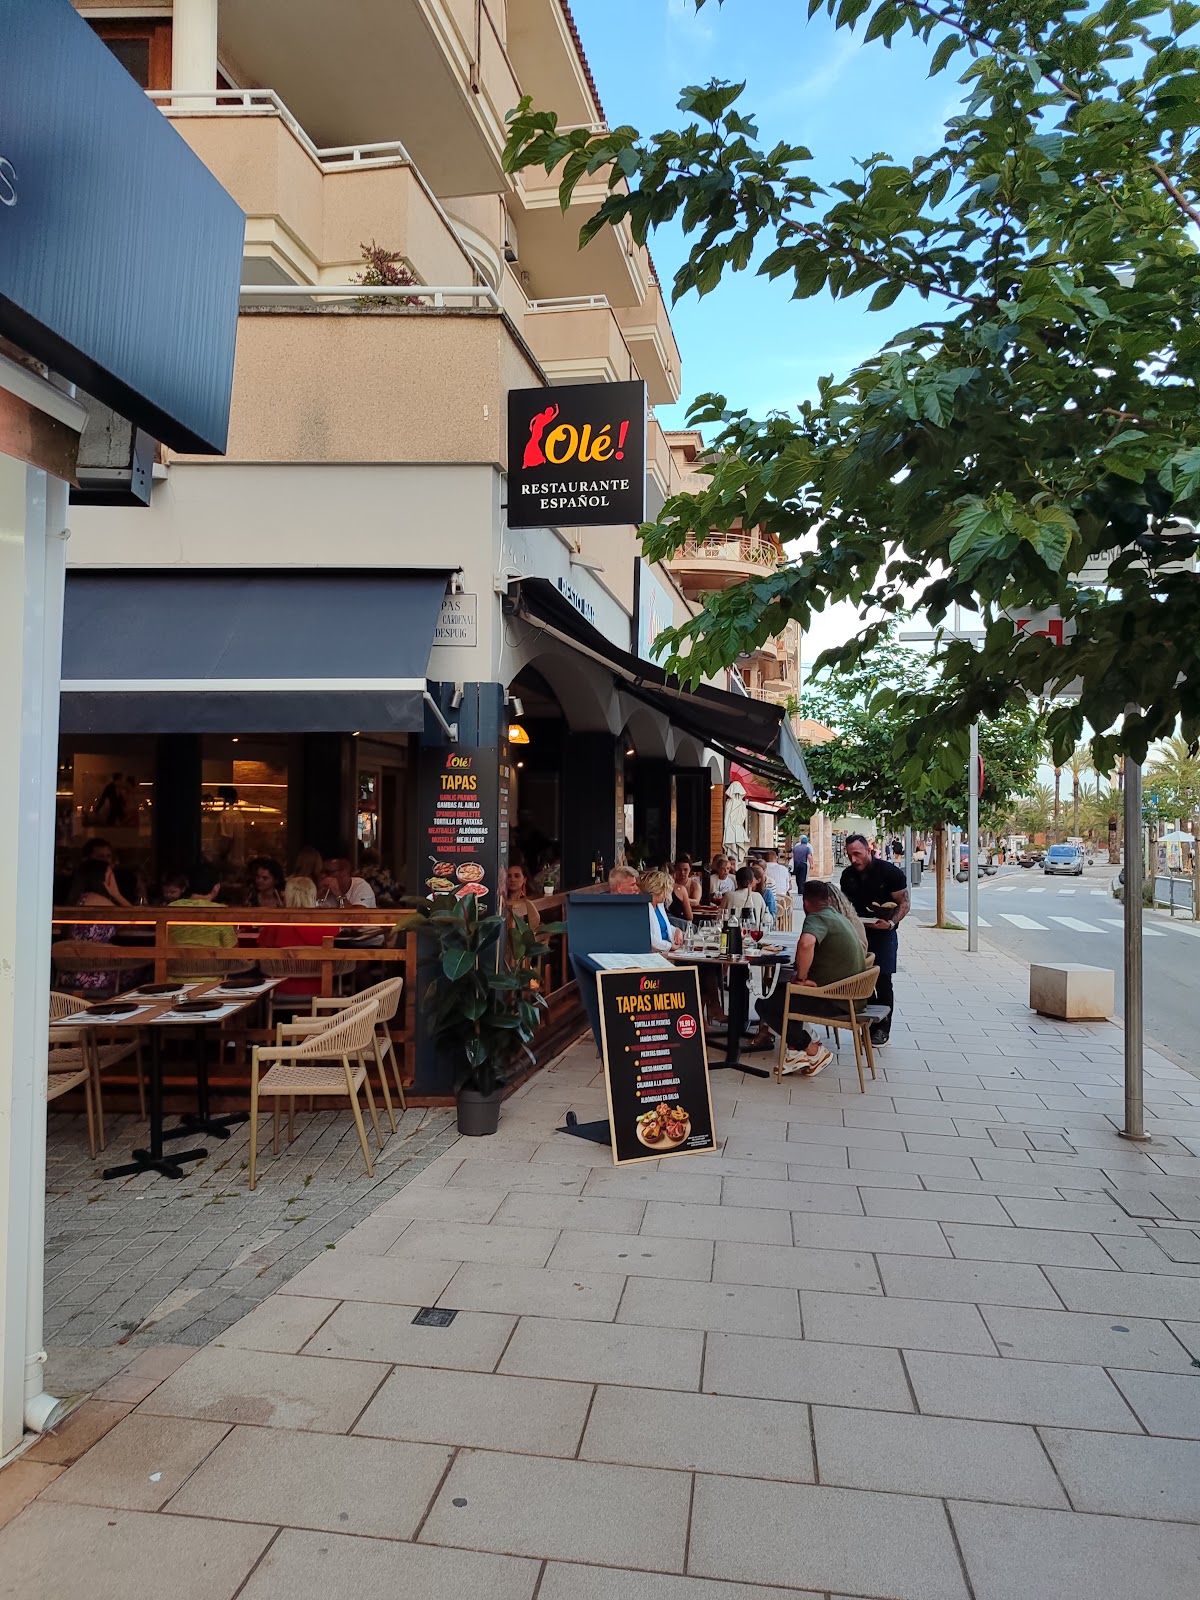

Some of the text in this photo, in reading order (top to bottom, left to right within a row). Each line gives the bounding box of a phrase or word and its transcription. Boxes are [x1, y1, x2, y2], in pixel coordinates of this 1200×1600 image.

[545, 420, 630, 465] Olé!
[521, 479, 630, 495] RESTAURANTE
[540, 494, 610, 509] ESPAÑOL
[441, 600, 461, 611] PAS
[442, 614, 475, 625] CARDENAL
[435, 627, 467, 638] DESPUIG
[440, 774, 477, 790] TAPAS
[437, 801, 457, 809] GAMBAS
[458, 801, 464, 809] AL
[433, 818, 484, 826] TORTILLA DE PATATAS
[615, 992, 686, 1014] TAPAS MENU
